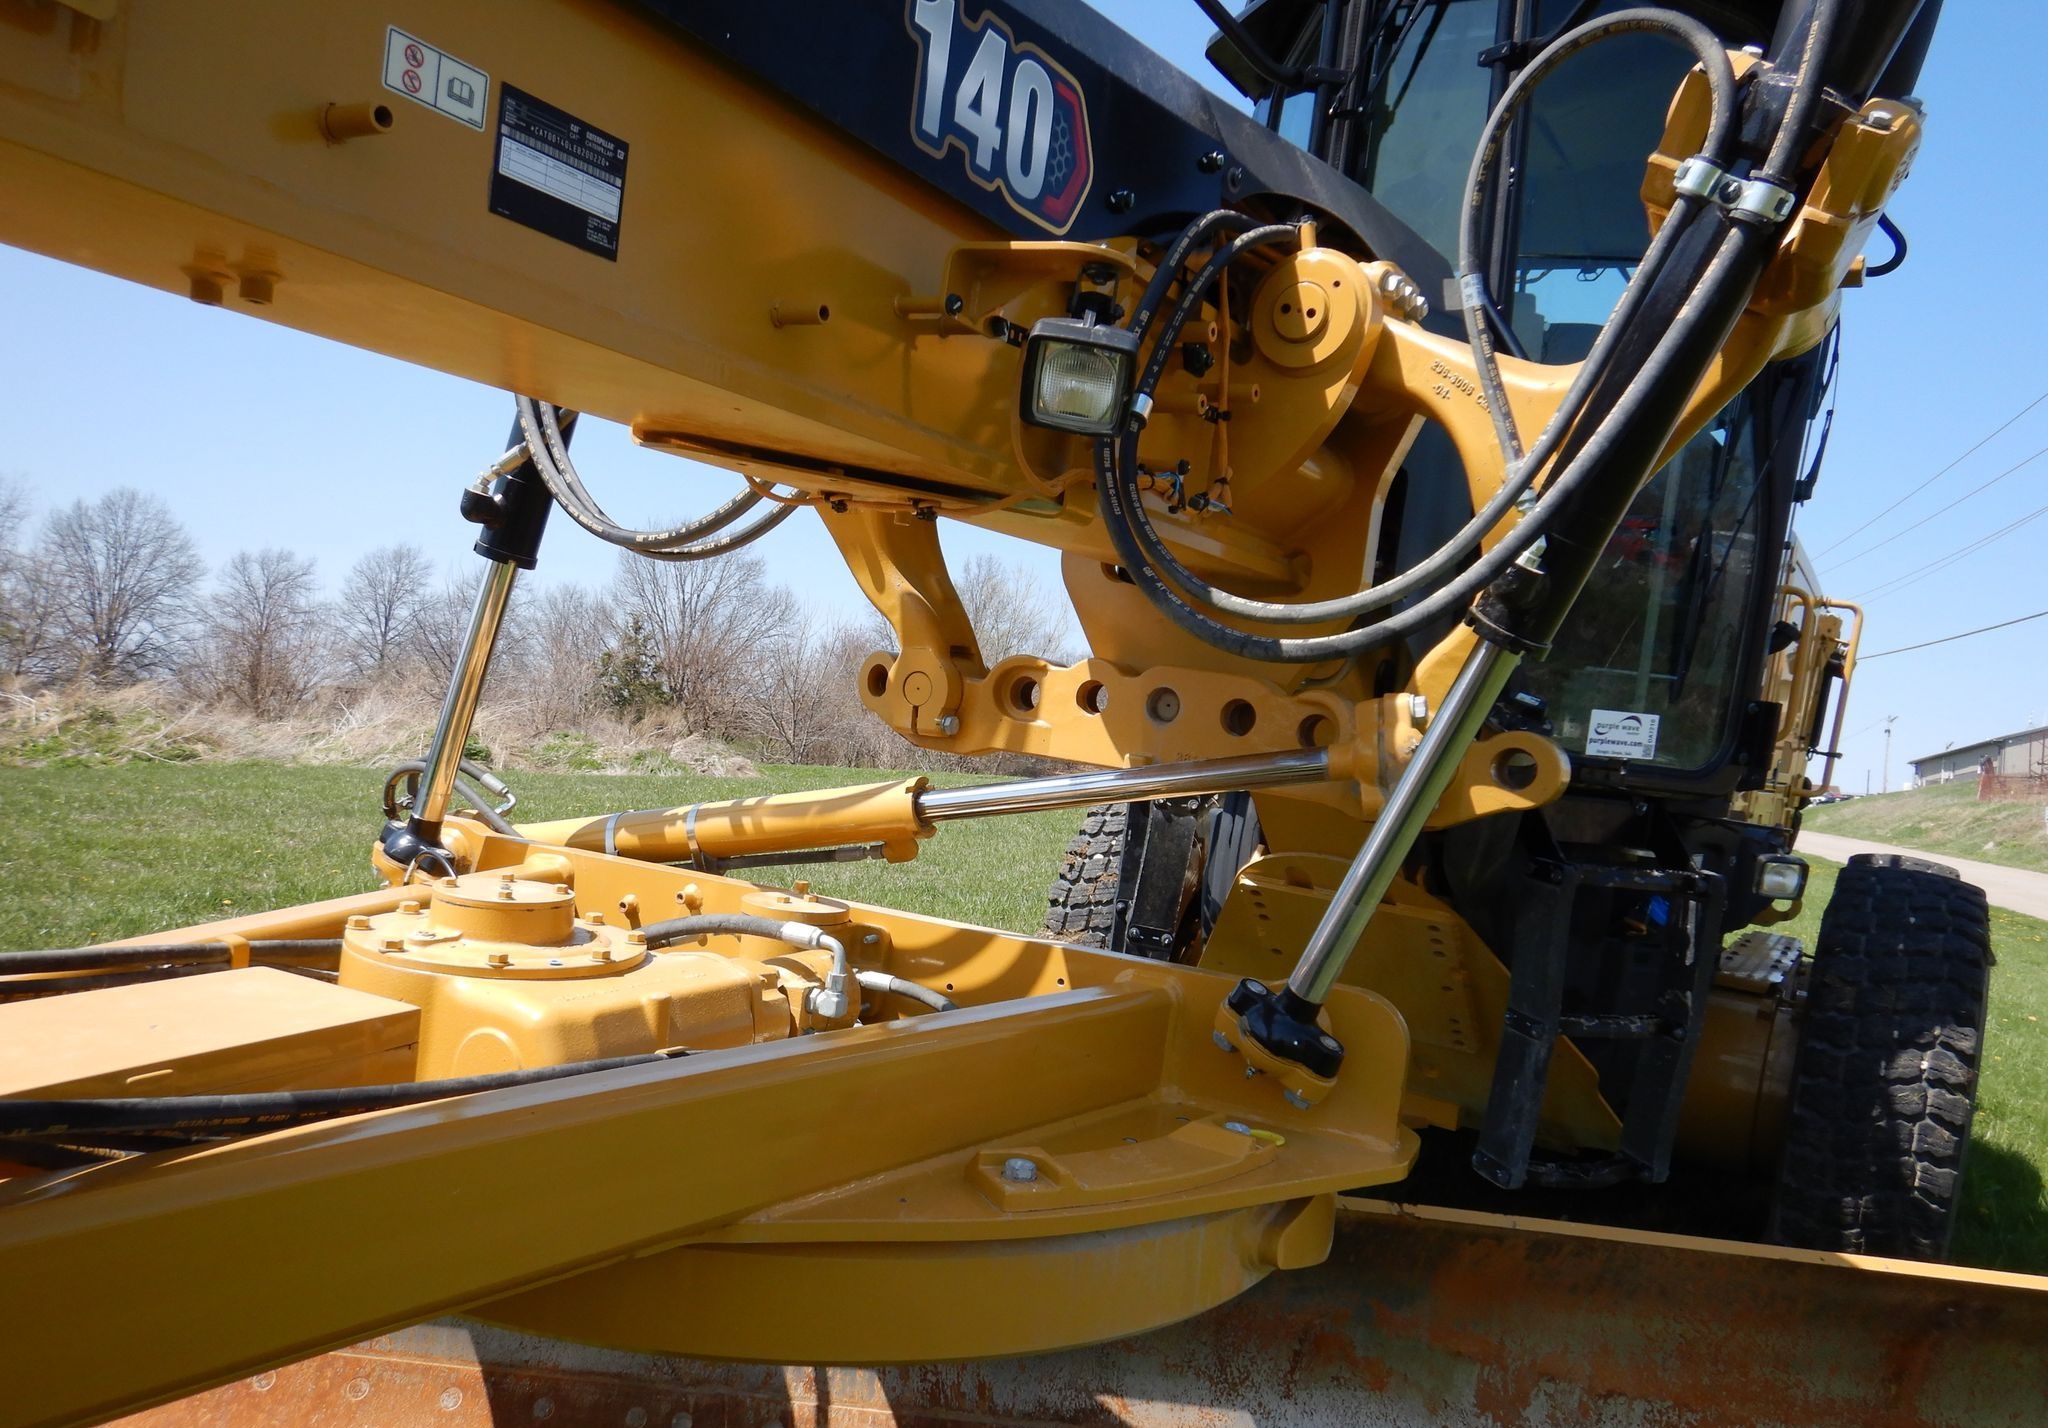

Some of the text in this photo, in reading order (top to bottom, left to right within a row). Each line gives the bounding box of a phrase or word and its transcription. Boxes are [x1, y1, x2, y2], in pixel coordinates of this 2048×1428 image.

[915, 0, 1054, 200] 140
[1596, 722, 1640, 732] purple wave
[1589, 737, 1643, 747] purplewave.com
